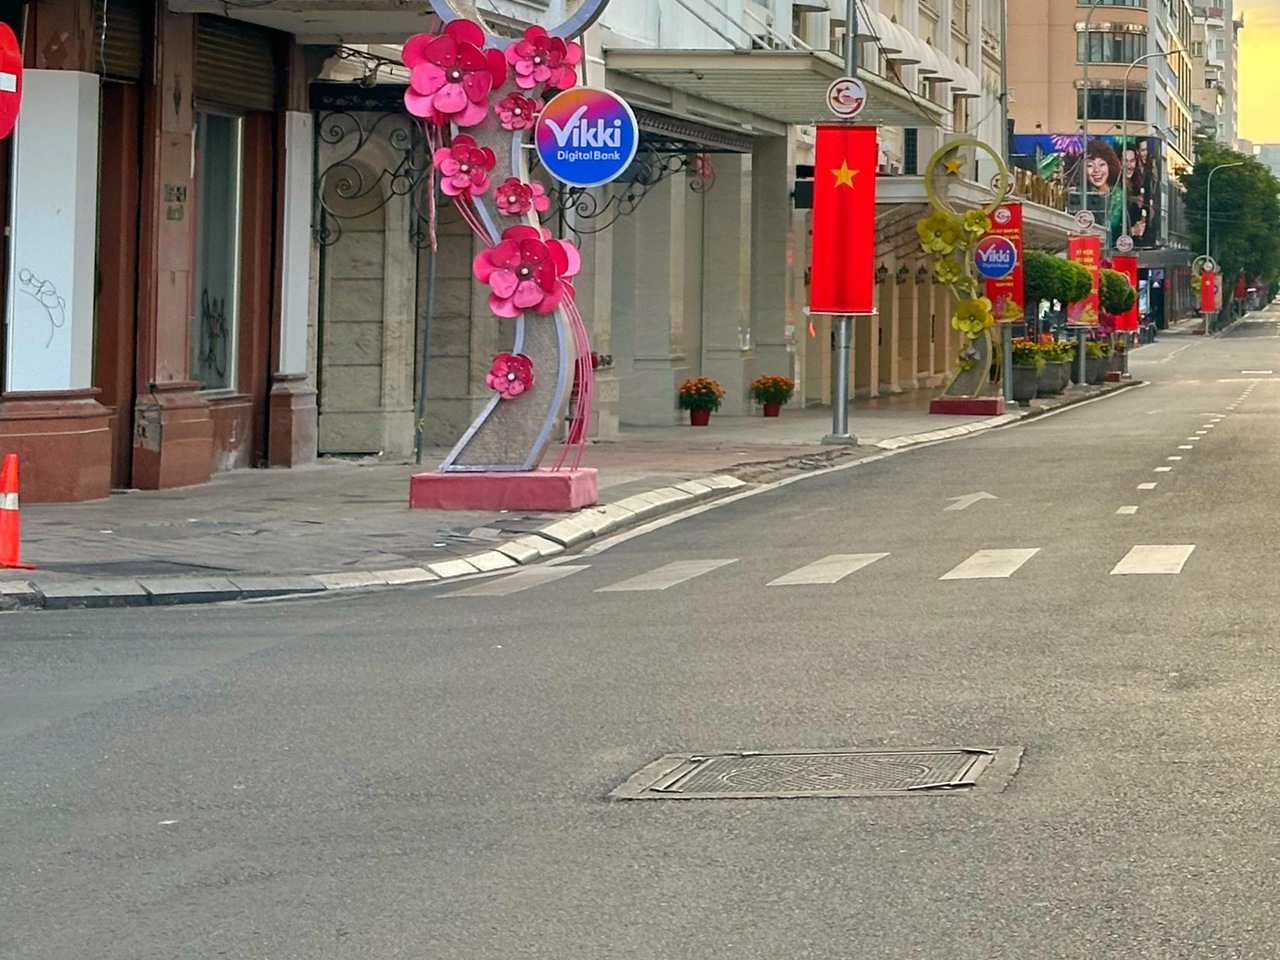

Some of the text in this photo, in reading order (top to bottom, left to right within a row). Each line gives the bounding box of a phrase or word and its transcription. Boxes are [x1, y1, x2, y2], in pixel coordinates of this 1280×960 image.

[544, 105, 621, 147] Vikki
[557, 151, 621, 162] Digital Bank
[978, 243, 1010, 262] Vikki
